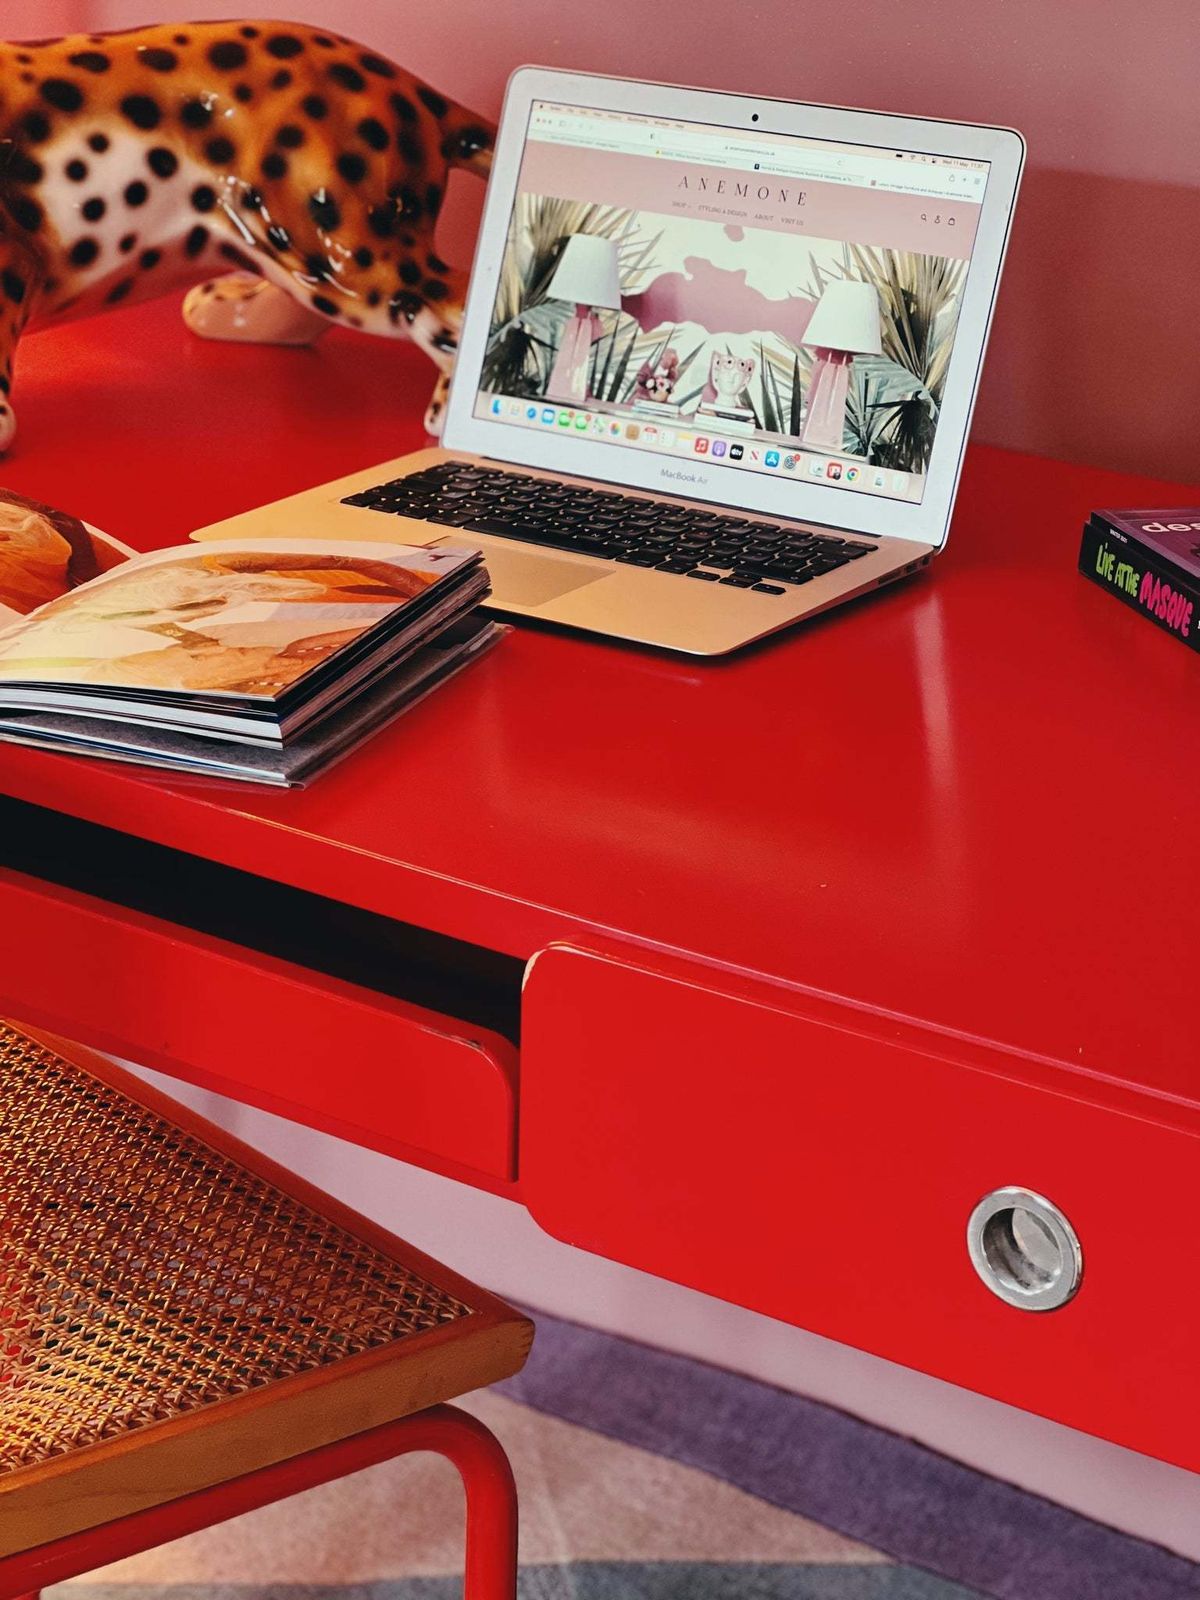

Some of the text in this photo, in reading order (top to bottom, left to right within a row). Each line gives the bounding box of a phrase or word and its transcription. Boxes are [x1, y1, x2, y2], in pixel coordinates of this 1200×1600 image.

[678, 175, 807, 207] ANEMONE
[660, 468, 696, 483] MacBook
[1139, 571, 1194, 637] MASQUE
